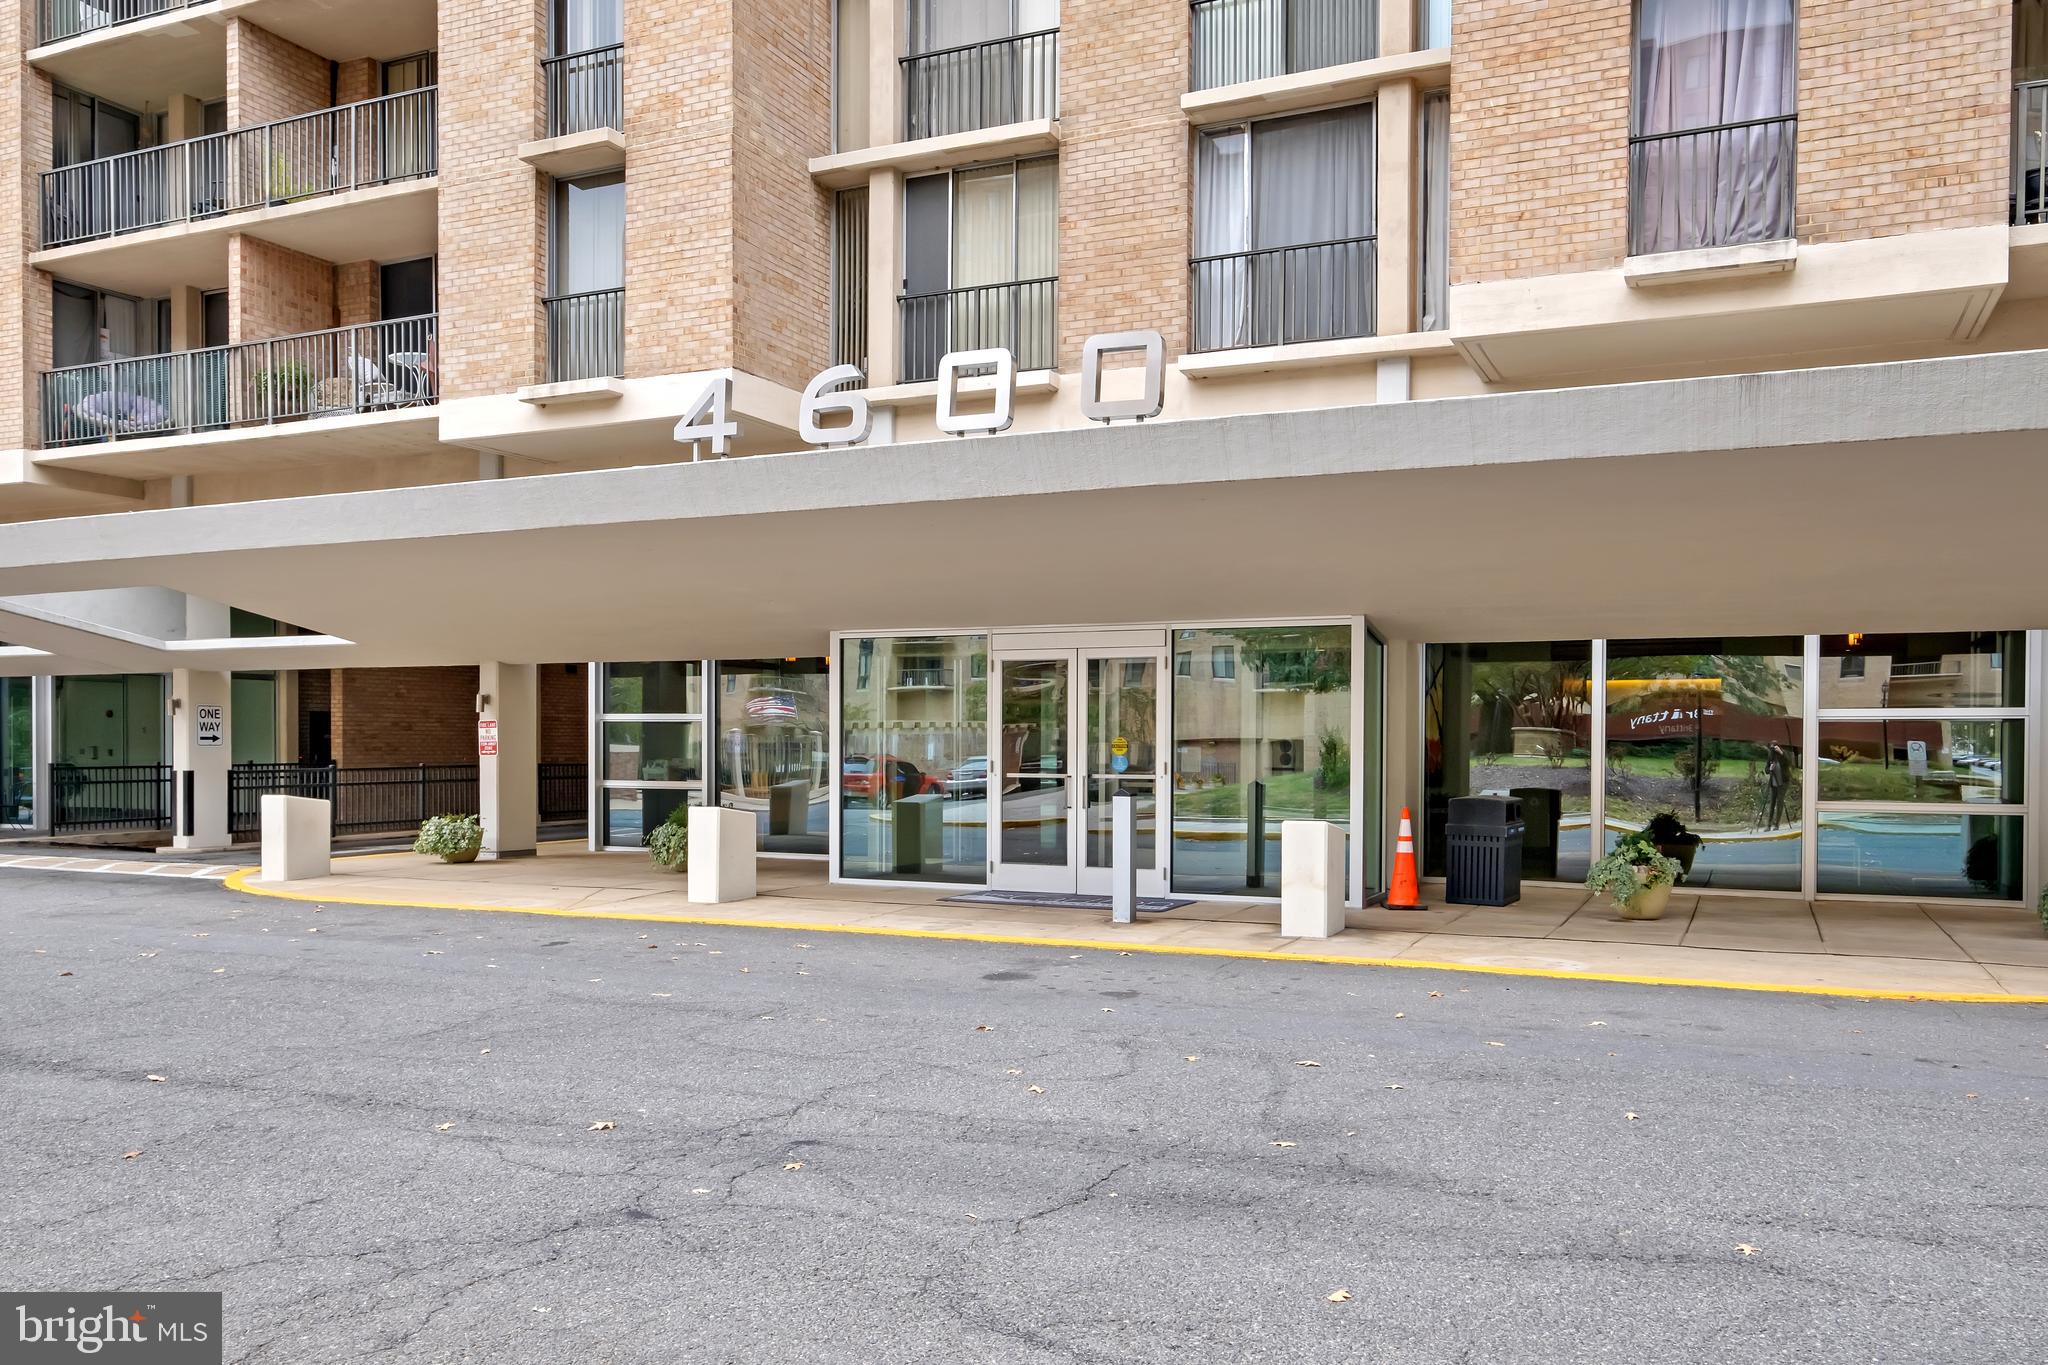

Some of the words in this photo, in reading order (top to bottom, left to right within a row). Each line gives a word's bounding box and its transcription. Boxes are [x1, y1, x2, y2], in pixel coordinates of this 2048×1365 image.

[673, 330, 1167, 454] 4600
[199, 708, 221, 719] ONE
[199, 721, 221, 732] WAY
